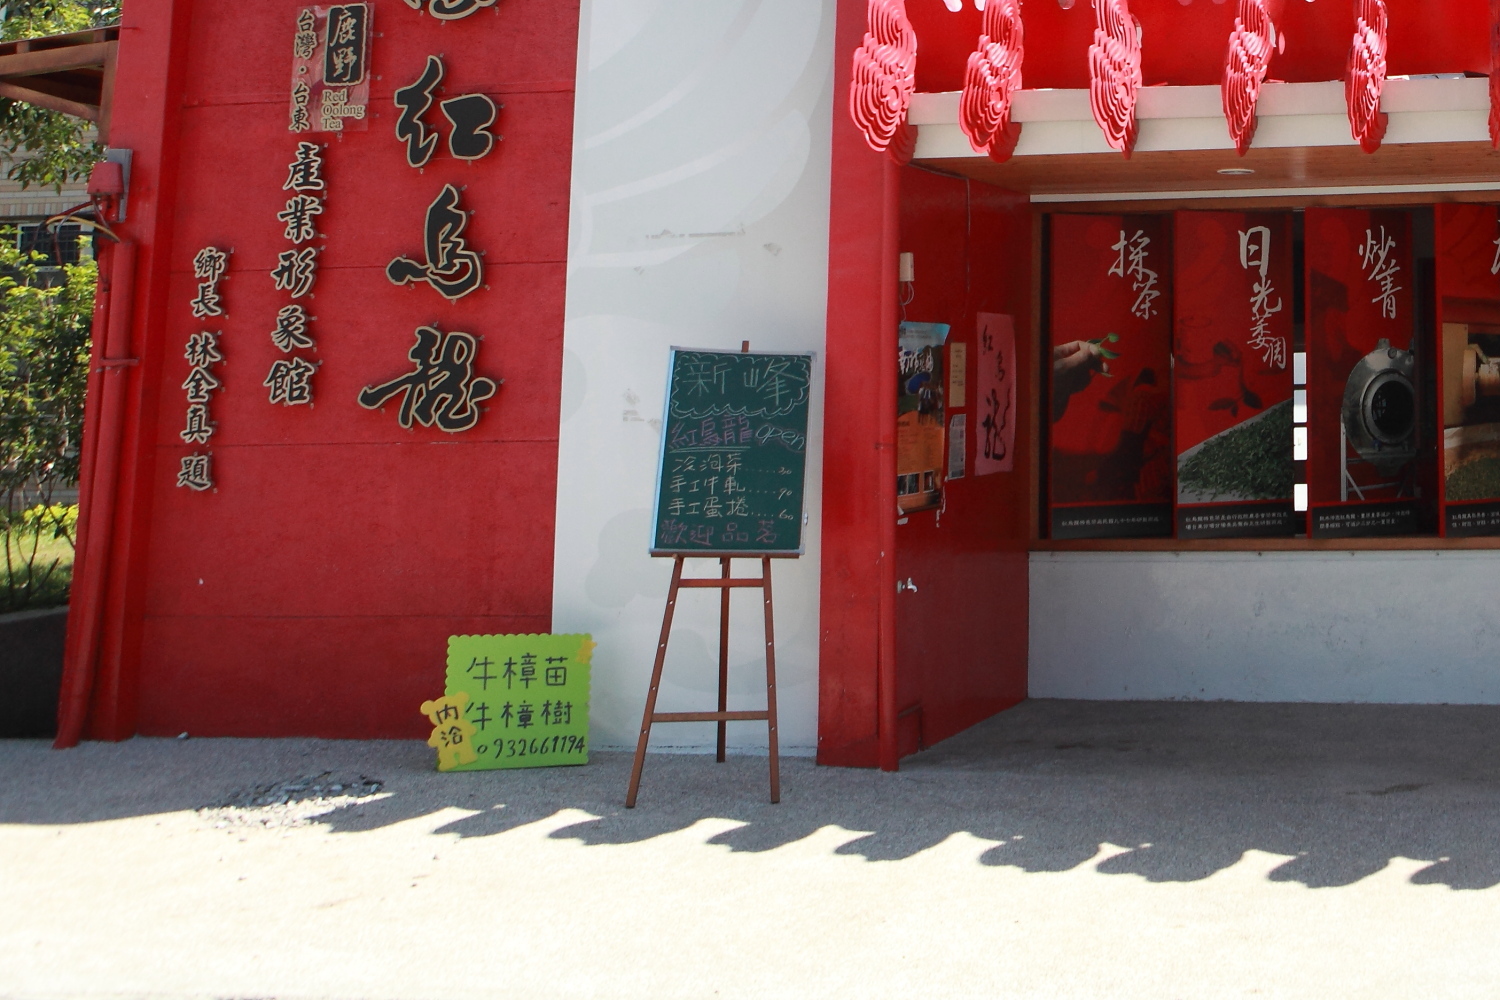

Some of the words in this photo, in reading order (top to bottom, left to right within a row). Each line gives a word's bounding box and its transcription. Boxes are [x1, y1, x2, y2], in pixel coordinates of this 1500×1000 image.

[329, 9, 358, 82] 鹿野
[322, 89, 347, 102] Red
[322, 104, 365, 119] Oolong
[322, 118, 343, 131] Tea
[358, 55, 496, 433] 紅烏龍
[191, 246, 226, 318] 鄉長
[263, 141, 324, 405] 產業形象館
[1107, 229, 1161, 320] 採茶
[180, 332, 222, 444] 林金真
[682, 356, 805, 406] 新峰
[177, 455, 213, 490] 題
[466, 652, 569, 691] 牛樟苗
[465, 700, 573, 731] 牛樟樹
